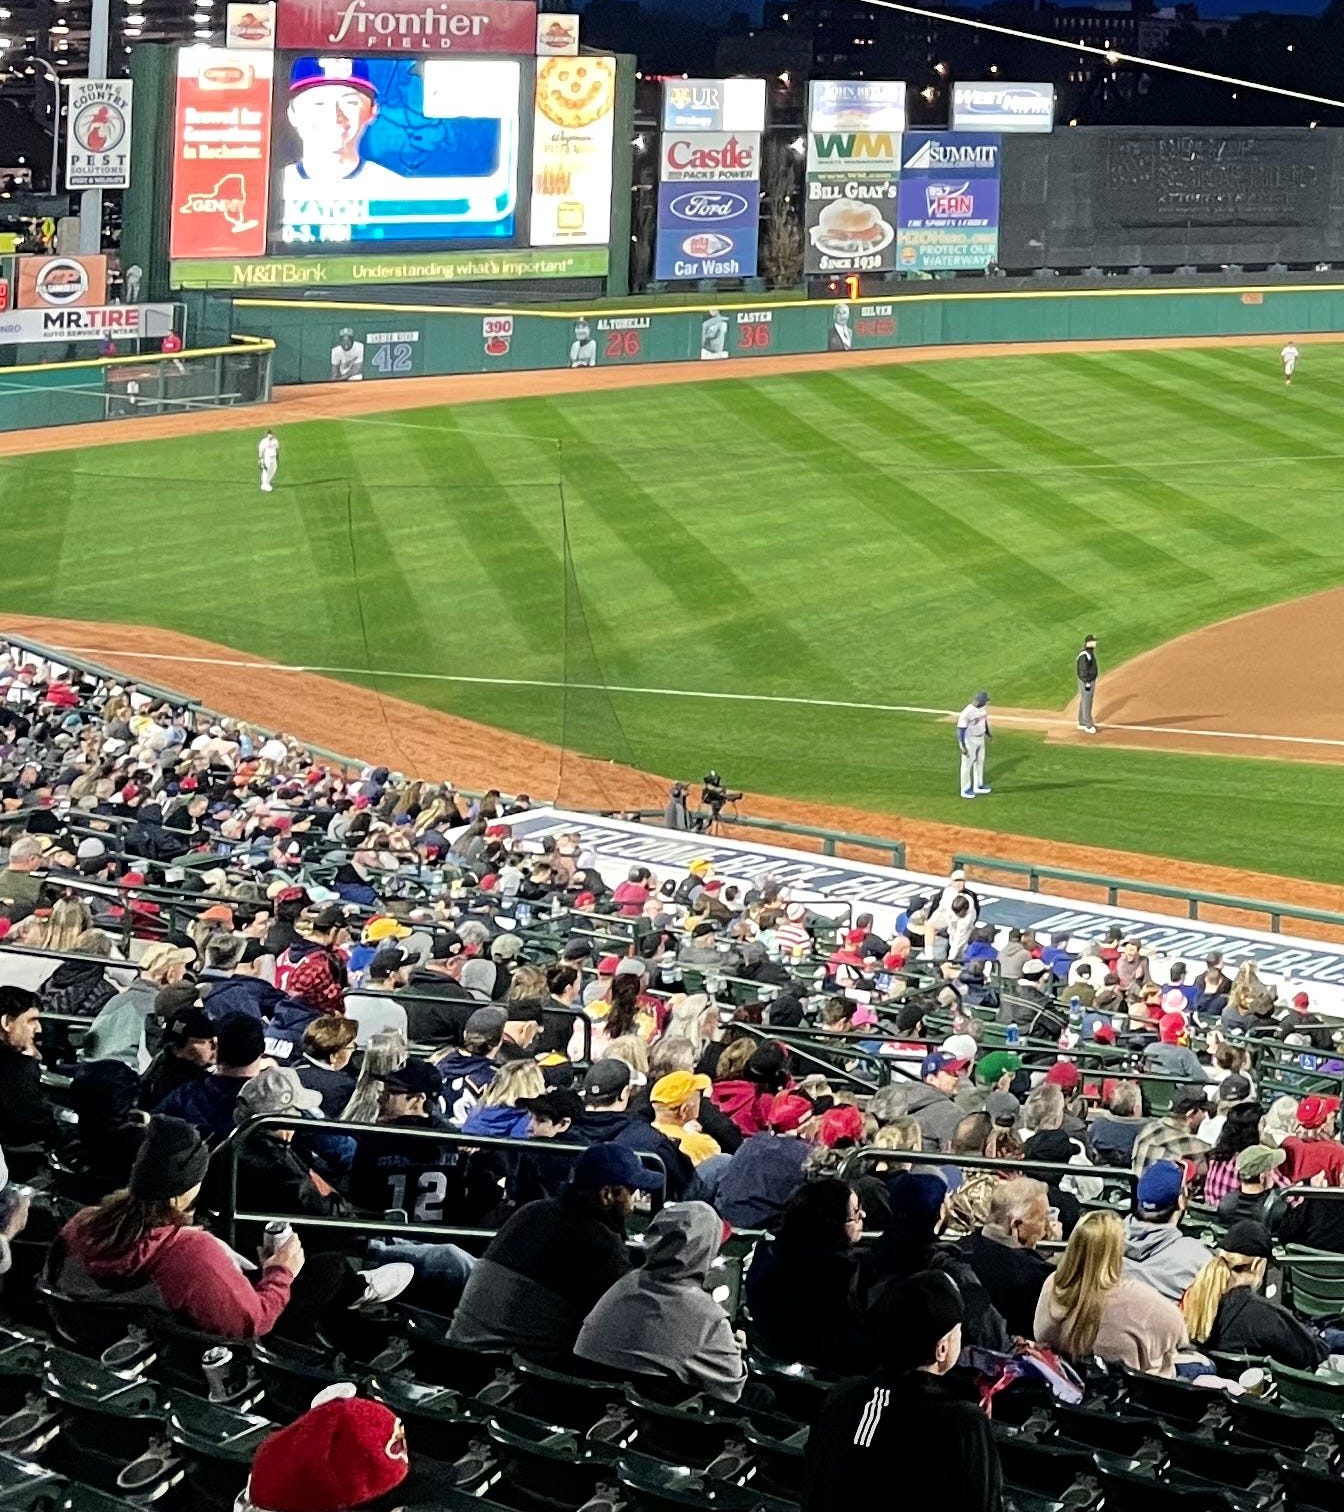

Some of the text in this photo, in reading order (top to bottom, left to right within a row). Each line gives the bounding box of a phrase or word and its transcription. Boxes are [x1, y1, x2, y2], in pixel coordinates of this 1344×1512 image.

[329, 0, 490, 43] frontier
[368, 36, 452, 49] FIELD
[80, 82, 113, 94] TOWN
[691, 88, 720, 107] UR
[73, 92, 128, 109] COUNTRY
[71, 155, 127, 166] PEST
[667, 134, 753, 170] Castle
[929, 146, 998, 163] SUMMIT
[71, 167, 123, 175] SOLUTIONS
[683, 170, 753, 180] PACKS POWER
[809, 182, 842, 201] BILL
[684, 194, 734, 217] Ford
[935, 195, 974, 216] FAN
[919, 244, 996, 255] PROTECT OUR
[352, 262, 454, 281] Understanding
[456, 260, 501, 276] what's
[674, 259, 739, 276] Car Wash
[853, 255, 882, 270] 1938
[43, 309, 140, 329] MR.TIRE
[484, 320, 512, 335] 390
[43, 330, 65, 338] AUTO
[67, 329, 101, 337] SERVICE
[739, 324, 771, 349] 36
[606, 329, 641, 358] 26
[371, 342, 413, 373] 42
[1029, 910, 1276, 968] WELCOME
[387, 1171, 448, 1222] 12
